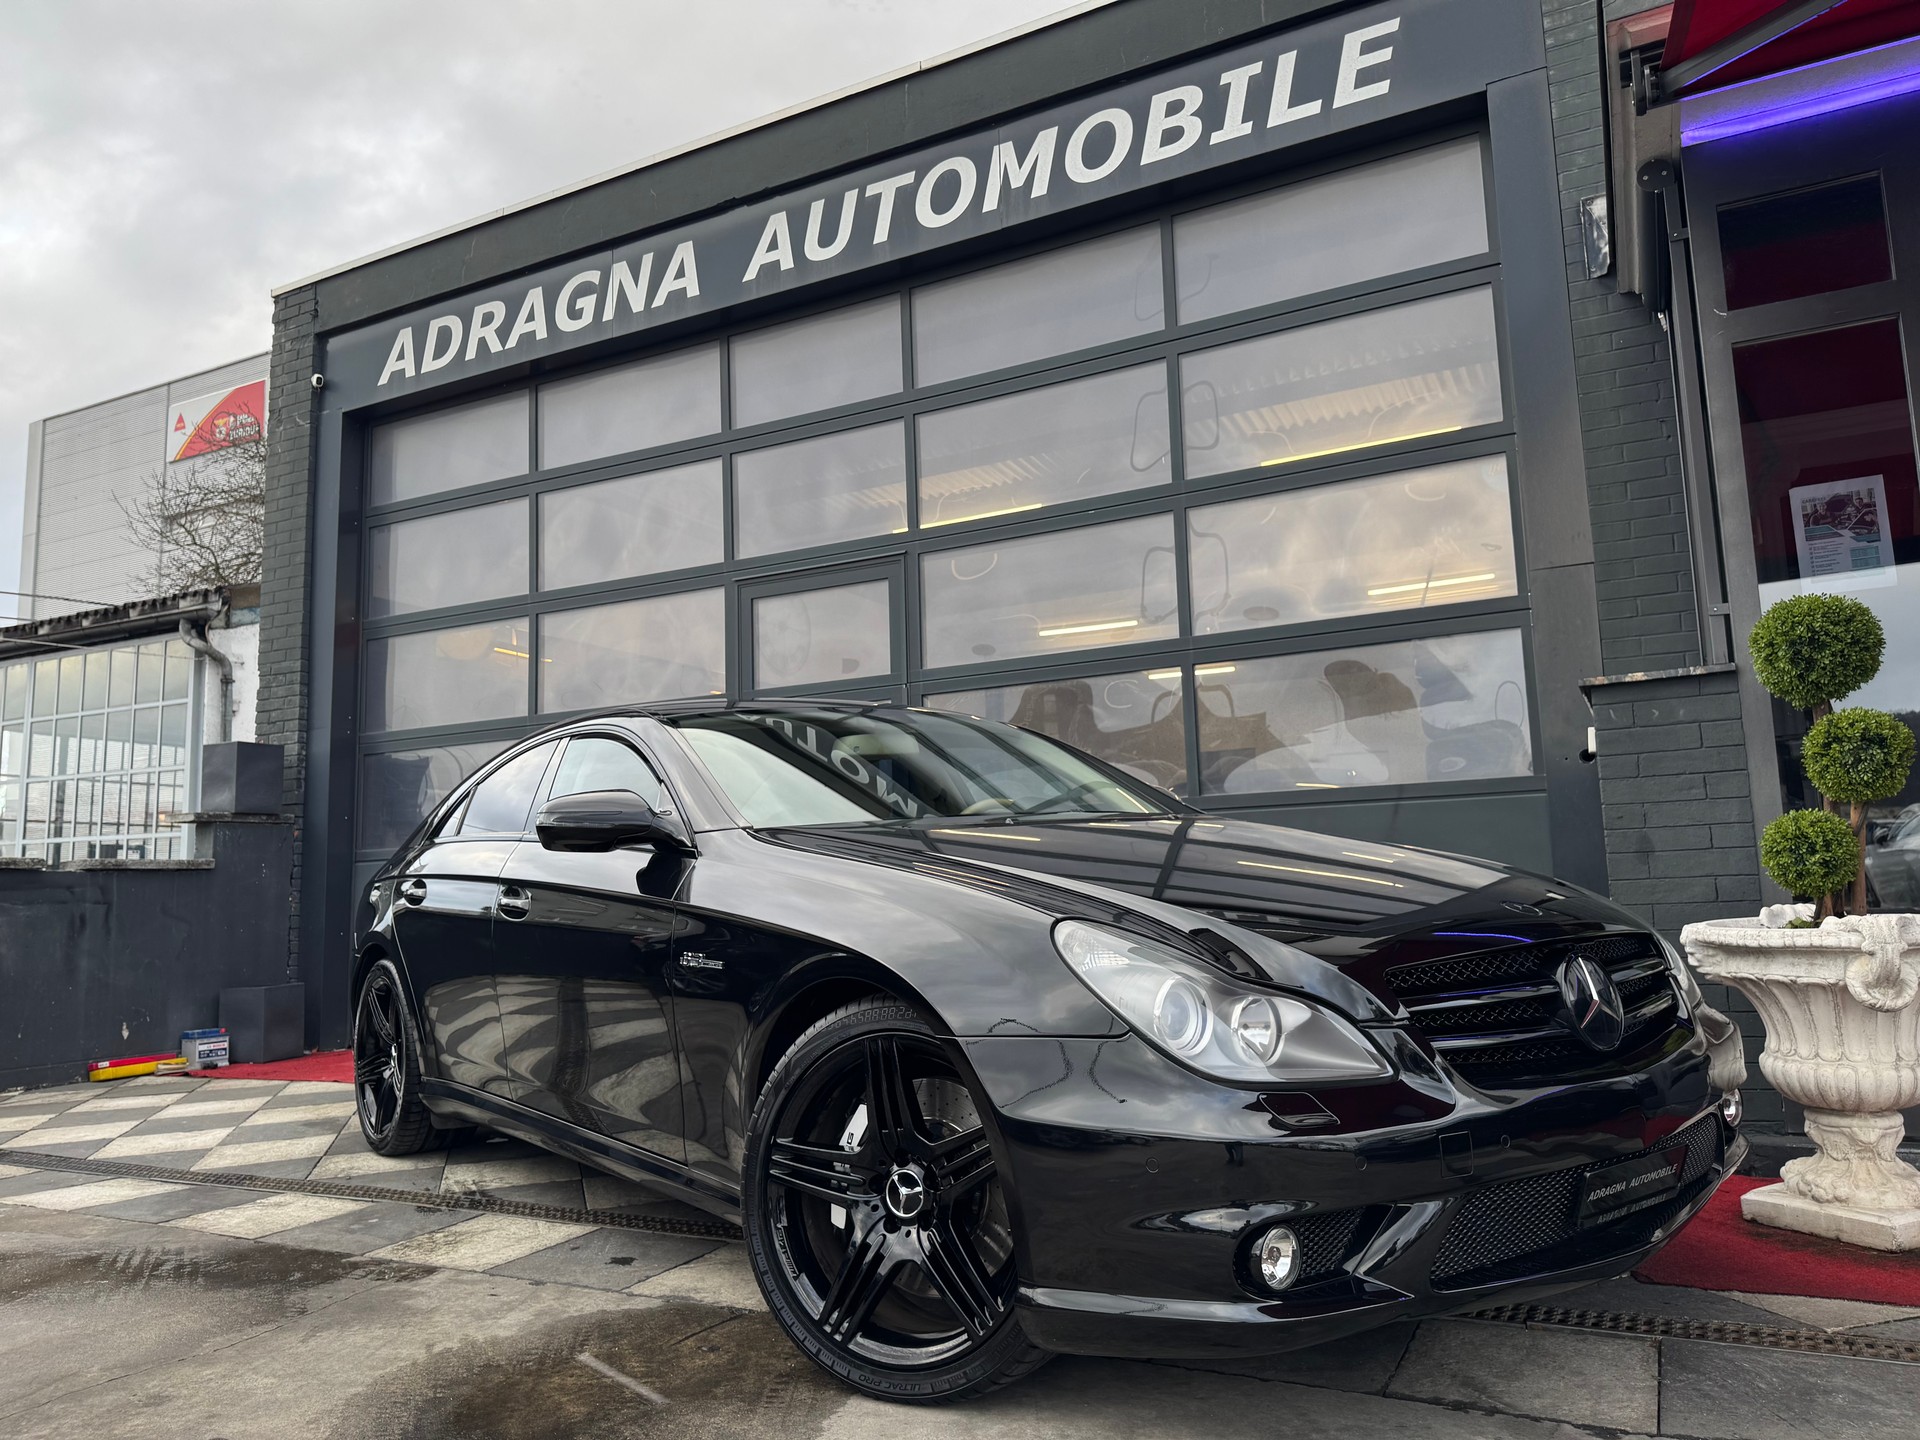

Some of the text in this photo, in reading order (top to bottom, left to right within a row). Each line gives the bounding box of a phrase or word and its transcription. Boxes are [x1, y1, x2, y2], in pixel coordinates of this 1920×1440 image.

[376, 16, 1402, 387] ADRAGNA AUTOMOBILE
[1587, 1163, 1678, 1202] ADRAGNA AUTOMOBILE
[858, 1374, 921, 1392] ULTRAC PRO
